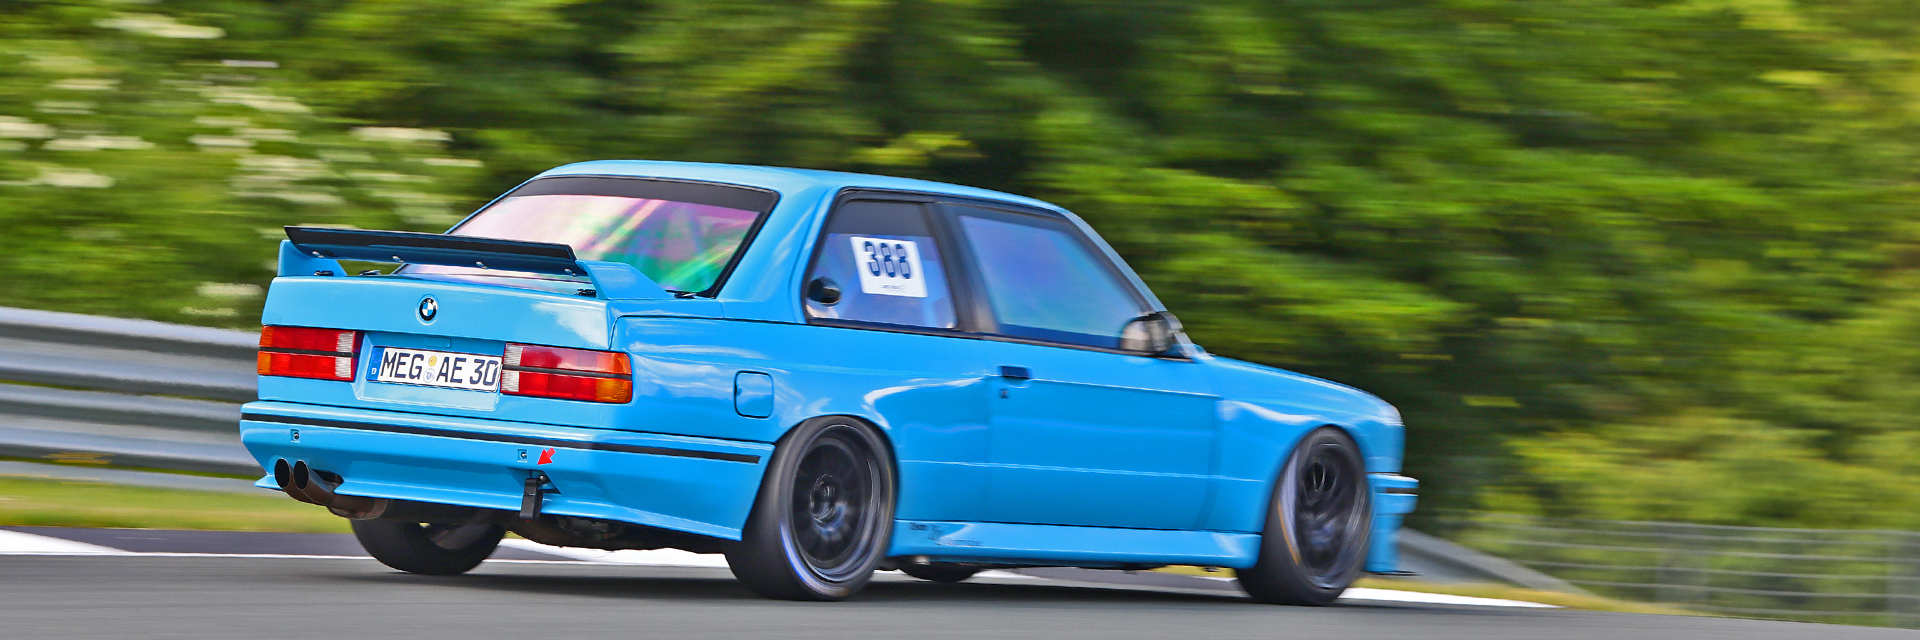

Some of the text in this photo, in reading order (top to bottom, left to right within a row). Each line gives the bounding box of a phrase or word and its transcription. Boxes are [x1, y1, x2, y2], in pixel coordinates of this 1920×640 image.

[864, 240, 911, 279] 388
[371, 367, 377, 375] D
[380, 351, 499, 386] MEG AE 30
